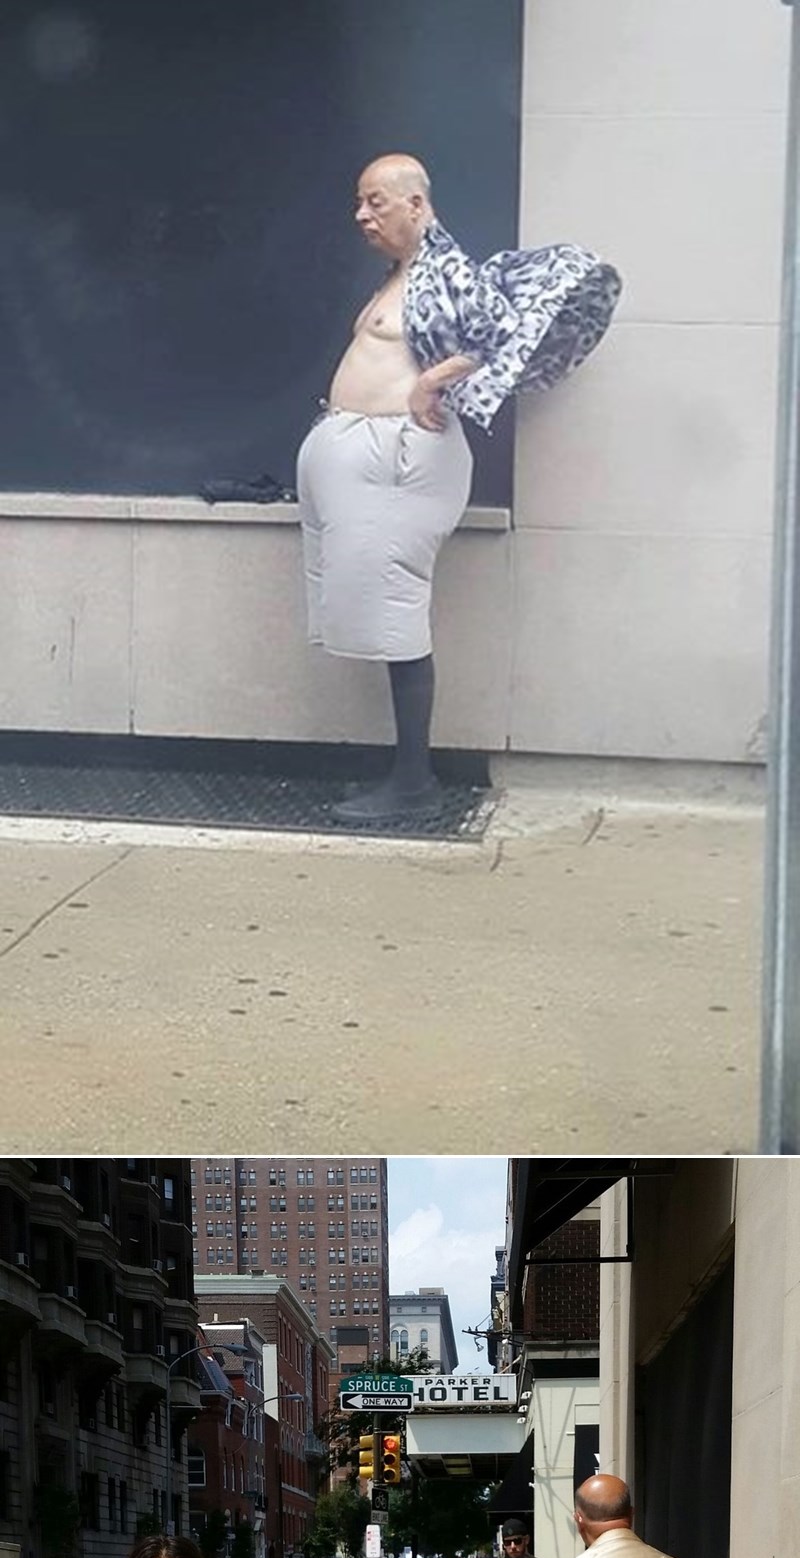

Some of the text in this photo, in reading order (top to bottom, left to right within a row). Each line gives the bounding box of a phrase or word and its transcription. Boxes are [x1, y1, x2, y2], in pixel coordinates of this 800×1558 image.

[348, 1381, 408, 1392] SPRUCE ST
[425, 1378, 491, 1386] PARKER
